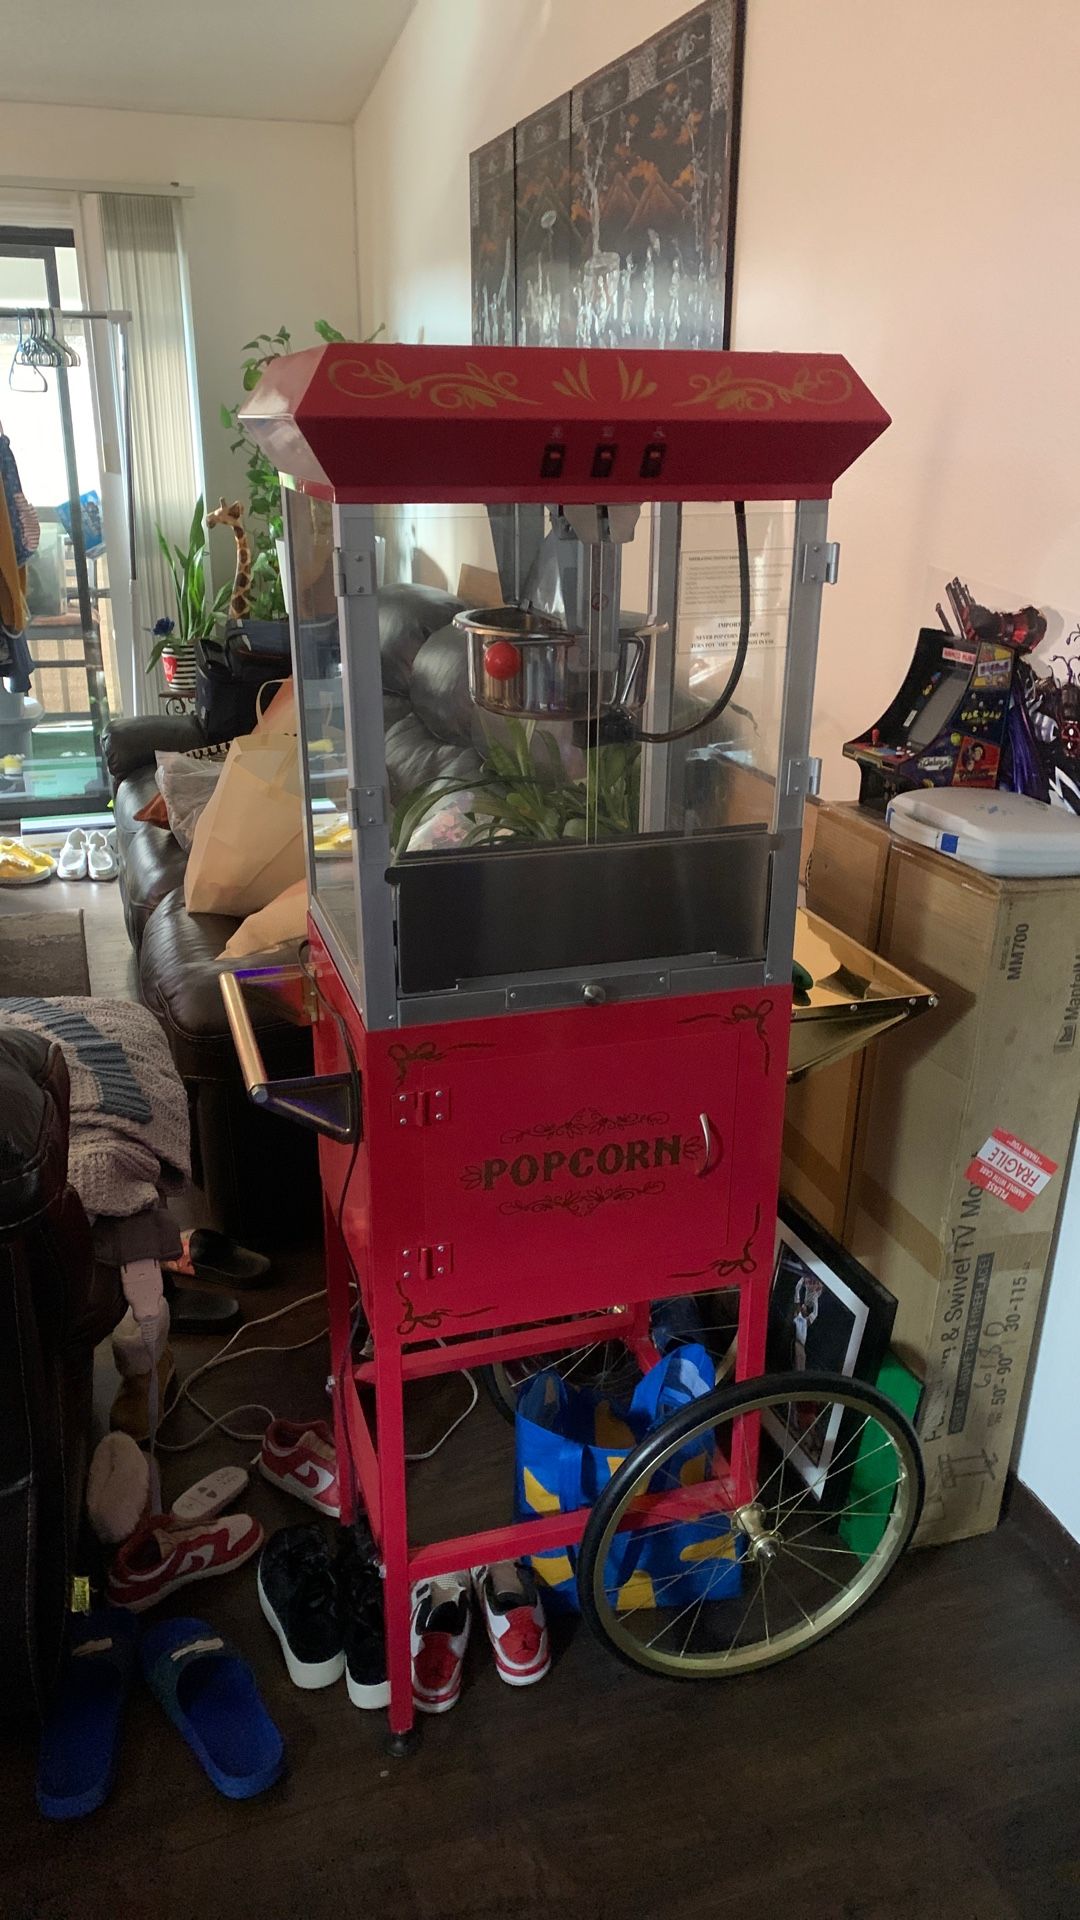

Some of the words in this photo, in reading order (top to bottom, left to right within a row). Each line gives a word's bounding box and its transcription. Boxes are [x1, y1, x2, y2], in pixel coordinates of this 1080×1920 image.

[1007, 923, 1029, 981] MM700
[482, 1134, 682, 1191] POPCORN
[979, 1165, 993, 1179] CARE
[988, 1146, 1040, 1188] FRAGILE
[985, 1181, 1010, 1200] PLEASE
[992, 1172, 1007, 1187] WITH
[1006, 1182, 1027, 1200] HANDLE
[951, 1225, 977, 1253] TV
[943, 1257, 972, 1323] Swivel
[965, 1326, 978, 1350] THE
